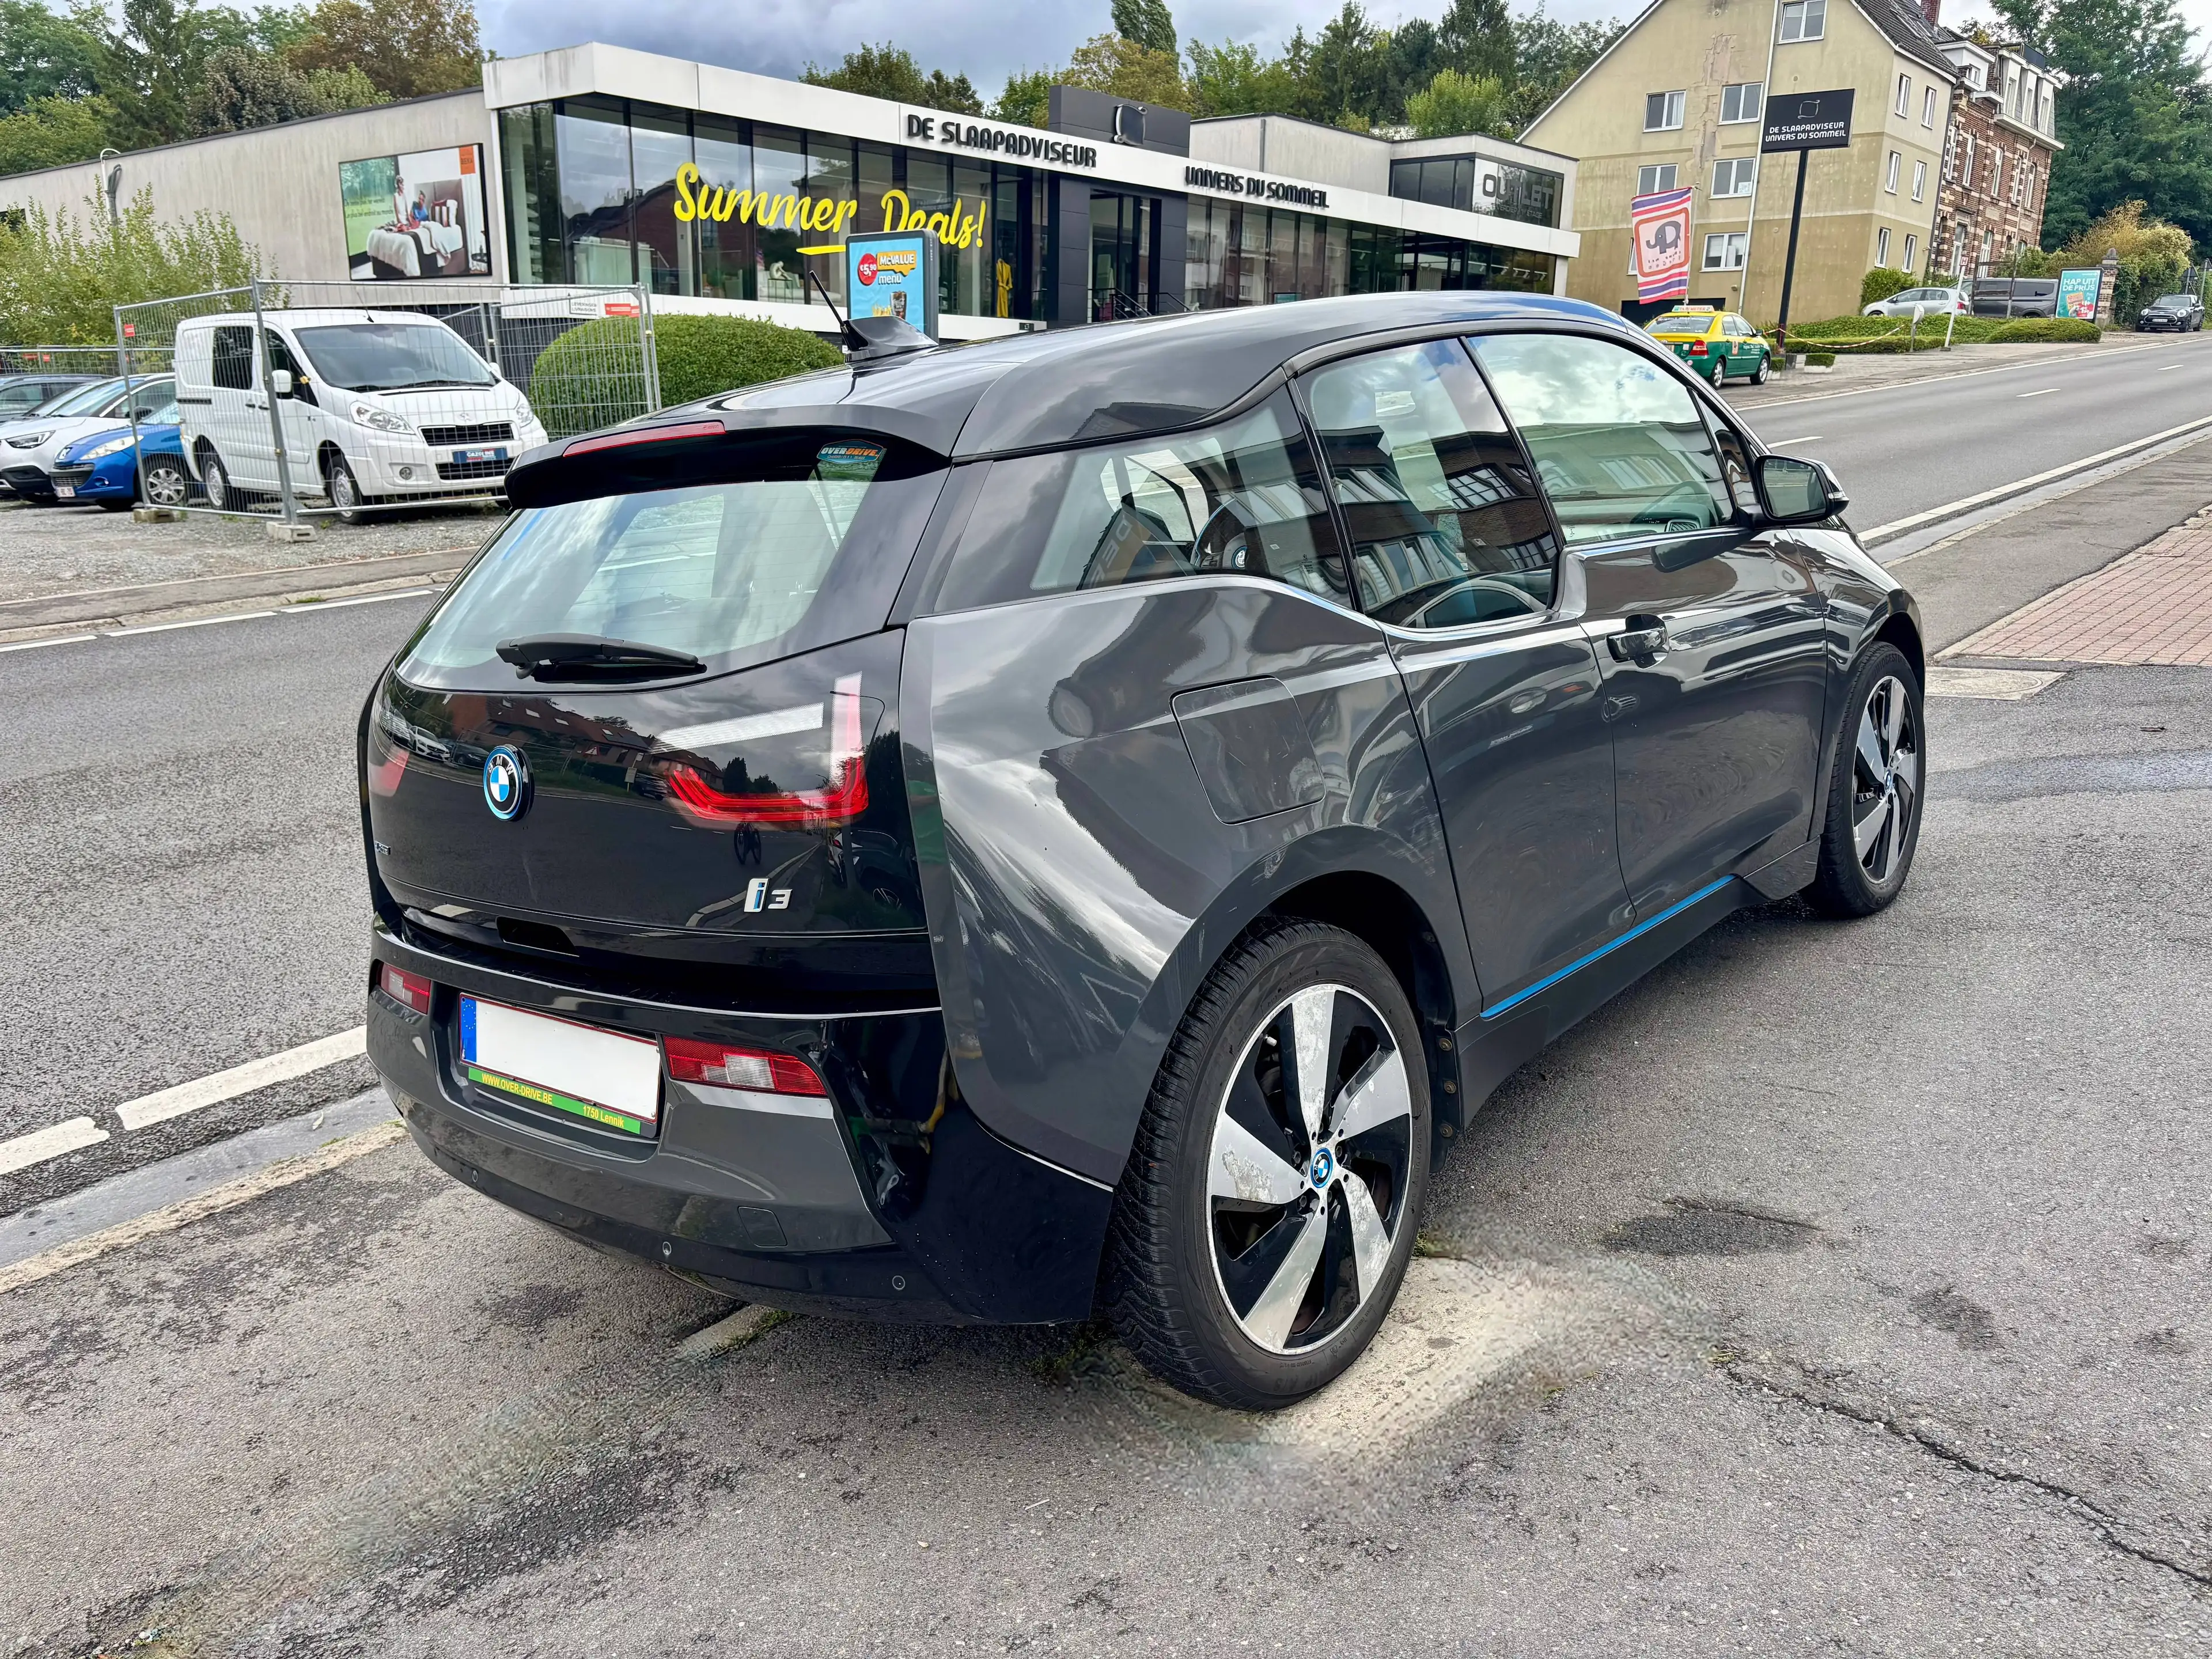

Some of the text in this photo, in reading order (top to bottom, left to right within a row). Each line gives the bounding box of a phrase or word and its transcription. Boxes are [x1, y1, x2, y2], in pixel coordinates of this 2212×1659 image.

[907, 114, 1097, 168] DE SLAAPADVISEUR
[1765, 134, 1796, 142] UNIVERS
[1808, 130, 1846, 139] SOMMEIL
[1781, 122, 1844, 132] SLAAPADVISEUR
[1184, 166, 1330, 209] UNIVERS DU SOMMEIL
[1482, 173, 1554, 209] OUTLET
[673, 162, 986, 249] Summer Deals!
[879, 253, 915, 266] McVALUE
[878, 274, 902, 285] menu
[744, 878, 793, 912] i3
[482, 1073, 553, 1105] WWW.OVER-DRIVE.BE
[583, 1105, 624, 1127] 1750 Lennik
